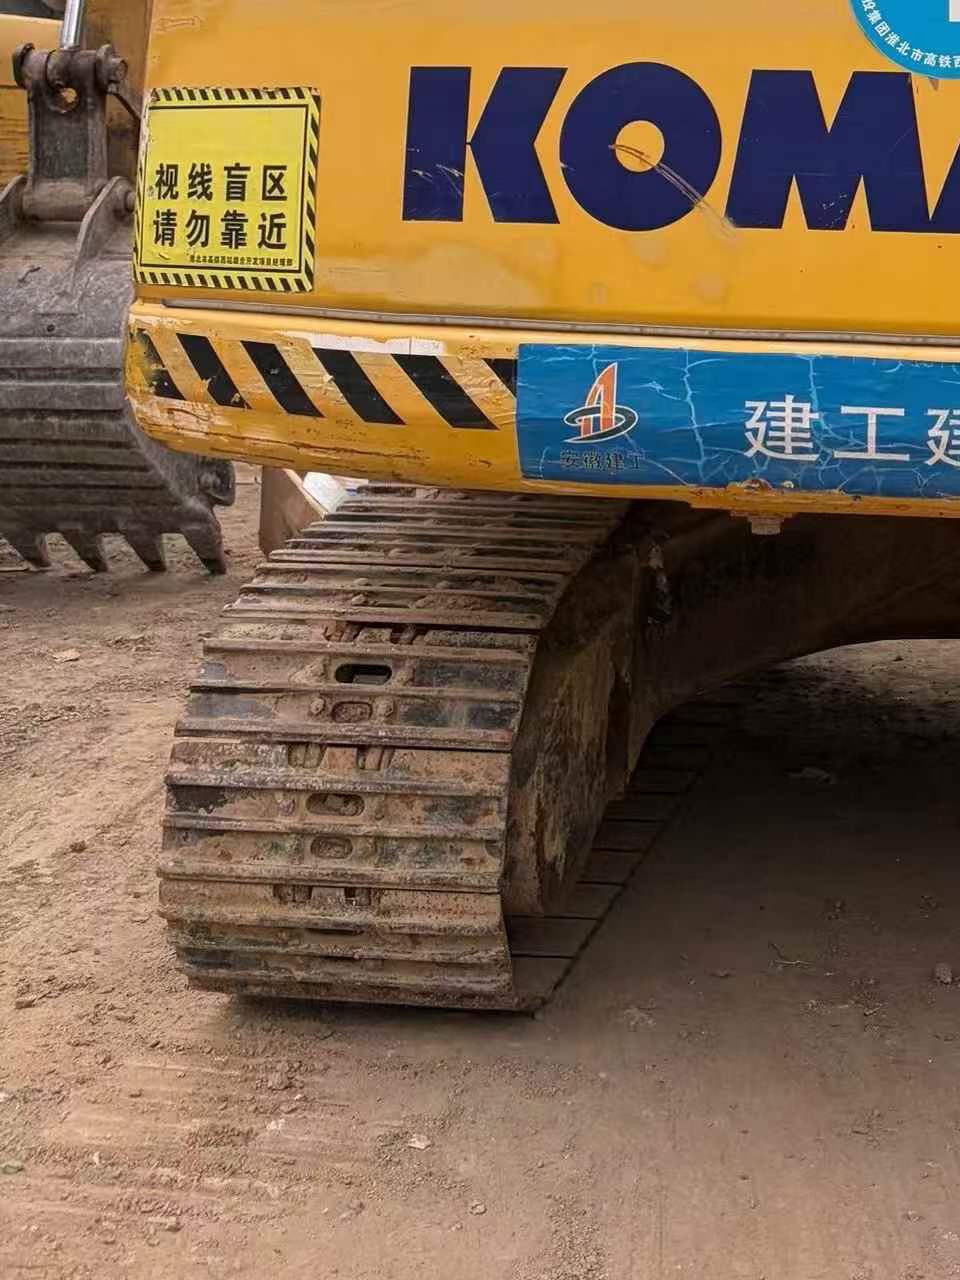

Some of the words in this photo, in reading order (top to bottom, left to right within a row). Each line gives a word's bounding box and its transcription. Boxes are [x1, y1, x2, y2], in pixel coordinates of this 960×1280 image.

[154, 162, 288, 202] 视线盲区
[153, 209, 288, 250] 请勿靠近
